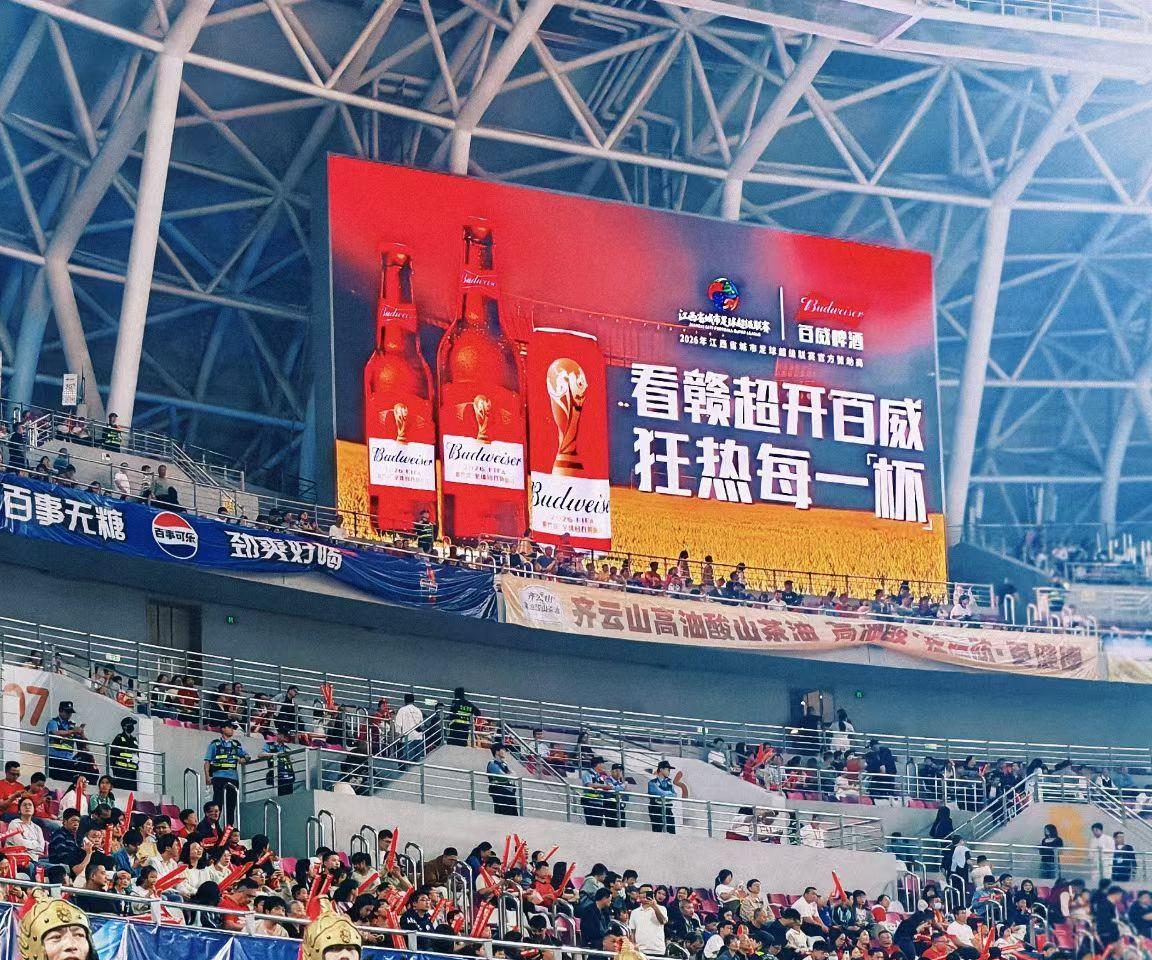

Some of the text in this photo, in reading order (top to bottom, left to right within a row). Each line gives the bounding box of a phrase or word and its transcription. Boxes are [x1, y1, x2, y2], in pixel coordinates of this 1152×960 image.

[801, 296, 865, 318] Budweiser
[797, 323, 864, 351] 百威啤酒
[630, 362, 925, 451] 看赣超开百威
[371, 446, 433, 467] Budweiser
[445, 441, 523, 467] Budweiser
[2, 483, 126, 541] 百事无糖
[153, 527, 196, 544] 百事可乐
[571, 596, 821, 643] 齐云山高油酸山茶油
